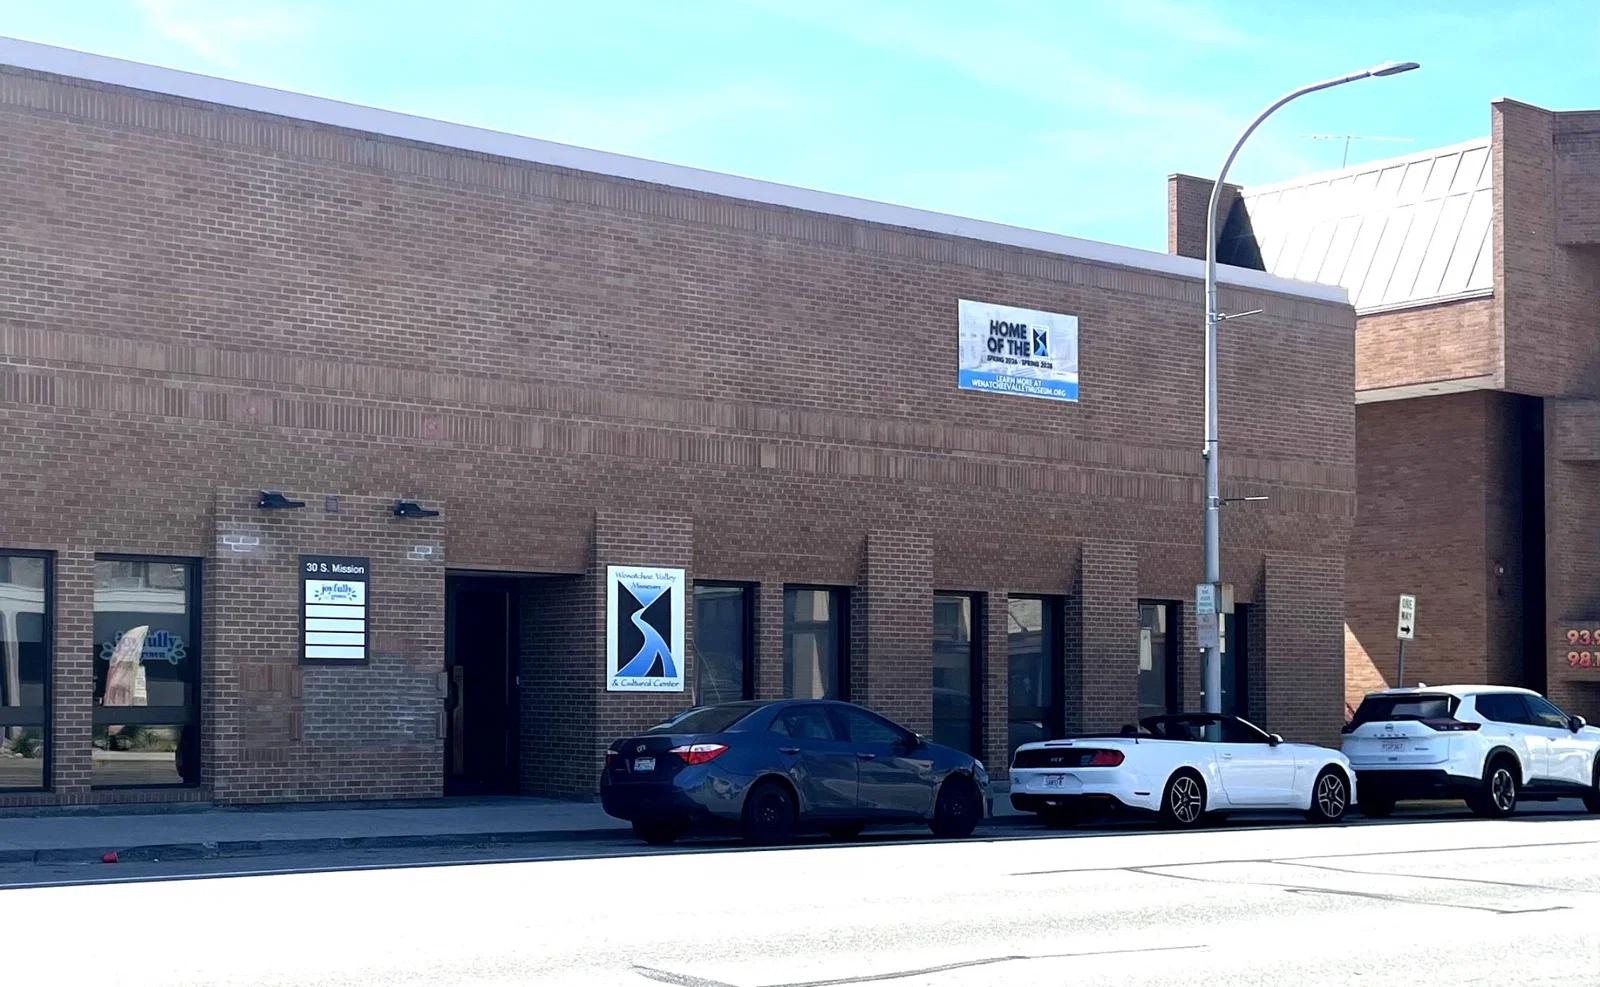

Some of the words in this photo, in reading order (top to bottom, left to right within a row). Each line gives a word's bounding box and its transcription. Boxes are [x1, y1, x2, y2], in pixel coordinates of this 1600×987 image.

[990, 320, 1027, 339] HOME
[987, 337, 1004, 354] OF
[1007, 339, 1031, 357] THE
[987, 354, 1004, 363] SPRING
[1021, 359, 1039, 367] SPRING
[996, 375, 1016, 384] LEARN
[1016, 377, 1033, 386] MORE
[1033, 379, 1042, 387] AT
[972, 379, 1066, 397] WENATCHEEVALLEYMUSEUM.ORG
[306, 563, 318, 572] 30
[320, 563, 330, 572] S.
[332, 563, 364, 574] Mission
[655, 573, 676, 582] Valley
[631, 582, 661, 590] Museum
[1401, 611, 1412, 621] WAY
[611, 679, 619, 687] &
[620, 679, 652, 687] Cultural
[653, 679, 679, 687] Center
